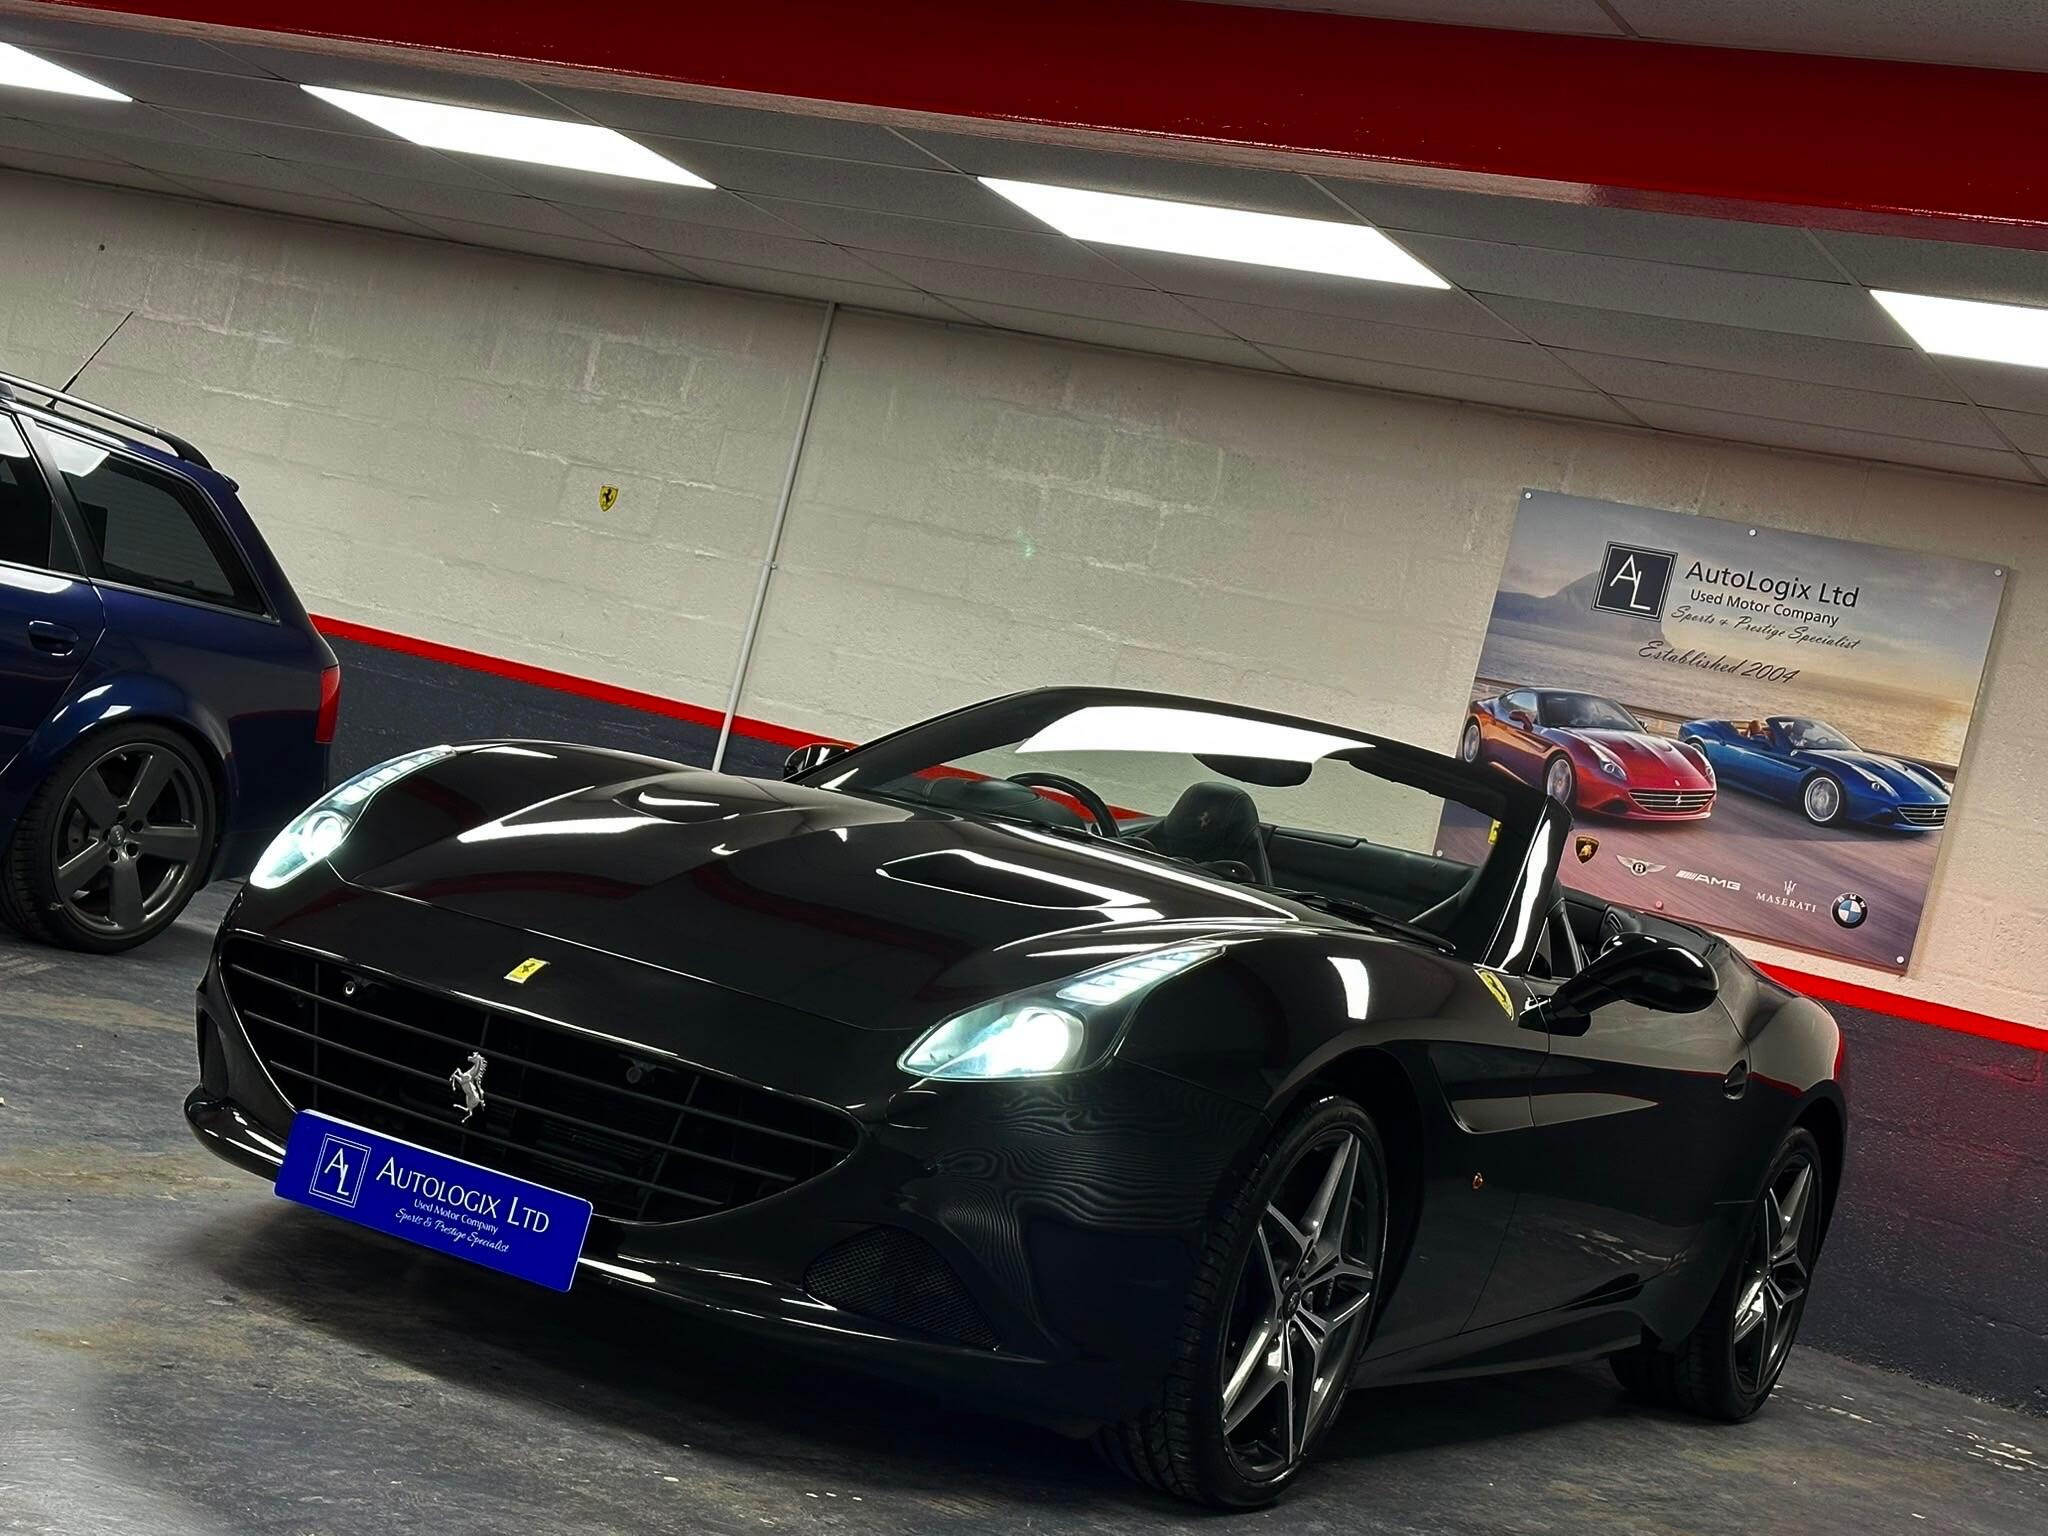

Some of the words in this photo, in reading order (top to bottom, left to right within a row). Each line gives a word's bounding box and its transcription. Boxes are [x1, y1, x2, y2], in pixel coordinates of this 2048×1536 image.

[1685, 561, 1812, 602] AutoLogix
[1818, 583, 1860, 607] Ltd
[1671, 605, 1716, 625] Sports
[1733, 616, 1786, 638] Prestige
[1787, 626, 1861, 650] Specialist
[1690, 588, 1723, 606] Used
[1726, 595, 1769, 613] Motor
[1773, 603, 1840, 628] Company
[1639, 640, 1744, 675] Established
[1741, 661, 1800, 684] 2004
[1695, 873, 1741, 891] AMG
[1756, 892, 1817, 913] MASERATI
[395, 1208, 423, 1226] Sports
[423, 1216, 433, 1228] &
[434, 1221, 467, 1243] Prestige
[466, 1230, 510, 1253] Specialist
[414, 1199, 434, 1212] Used
[435, 1205, 460, 1221] Motor
[461, 1213, 499, 1235] Company
